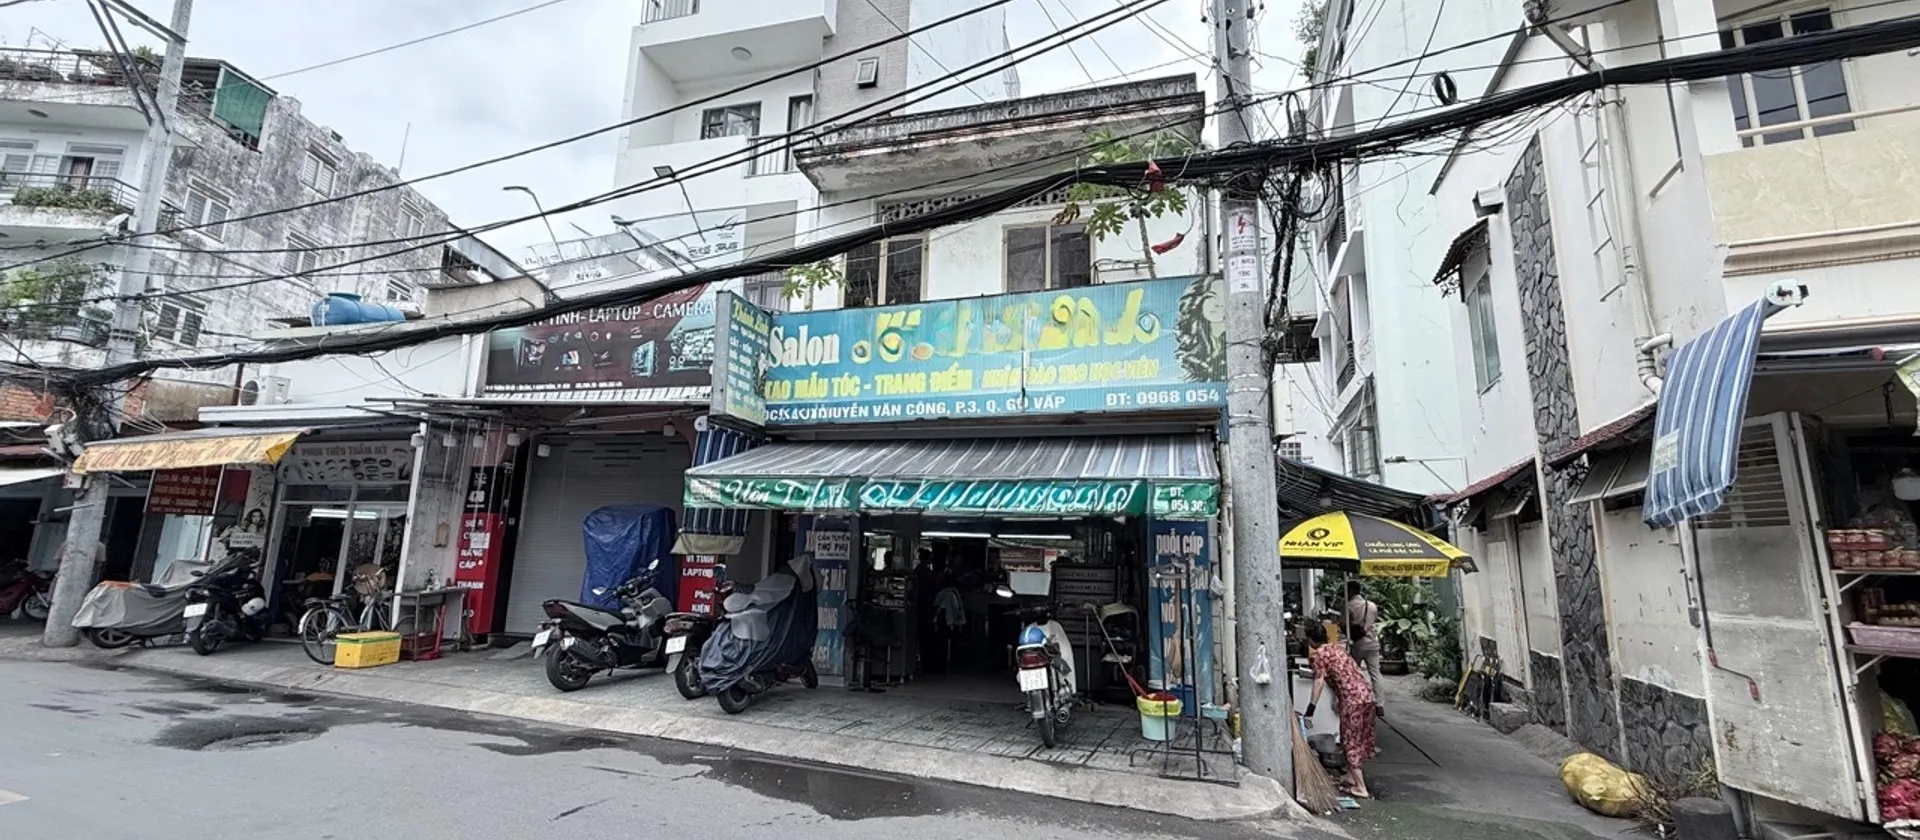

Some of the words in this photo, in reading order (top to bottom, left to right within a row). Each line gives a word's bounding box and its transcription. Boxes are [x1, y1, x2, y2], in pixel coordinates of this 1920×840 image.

[589, 306, 641, 322] LAPTOP
[653, 301, 714, 319] CAMERA
[767, 325, 840, 369] Salon
[831, 371, 861, 397] TÓC
[874, 372, 926, 395] TRANG
[873, 403, 901, 417] VĂN
[906, 401, 950, 415] CÔNG,
[986, 399, 1000, 413] Q.
[1033, 391, 1066, 410] VẤP
[1106, 392, 1131, 406] ĐT:
[1136, 390, 1180, 405] 0968
[1186, 389, 1220, 403] 054
